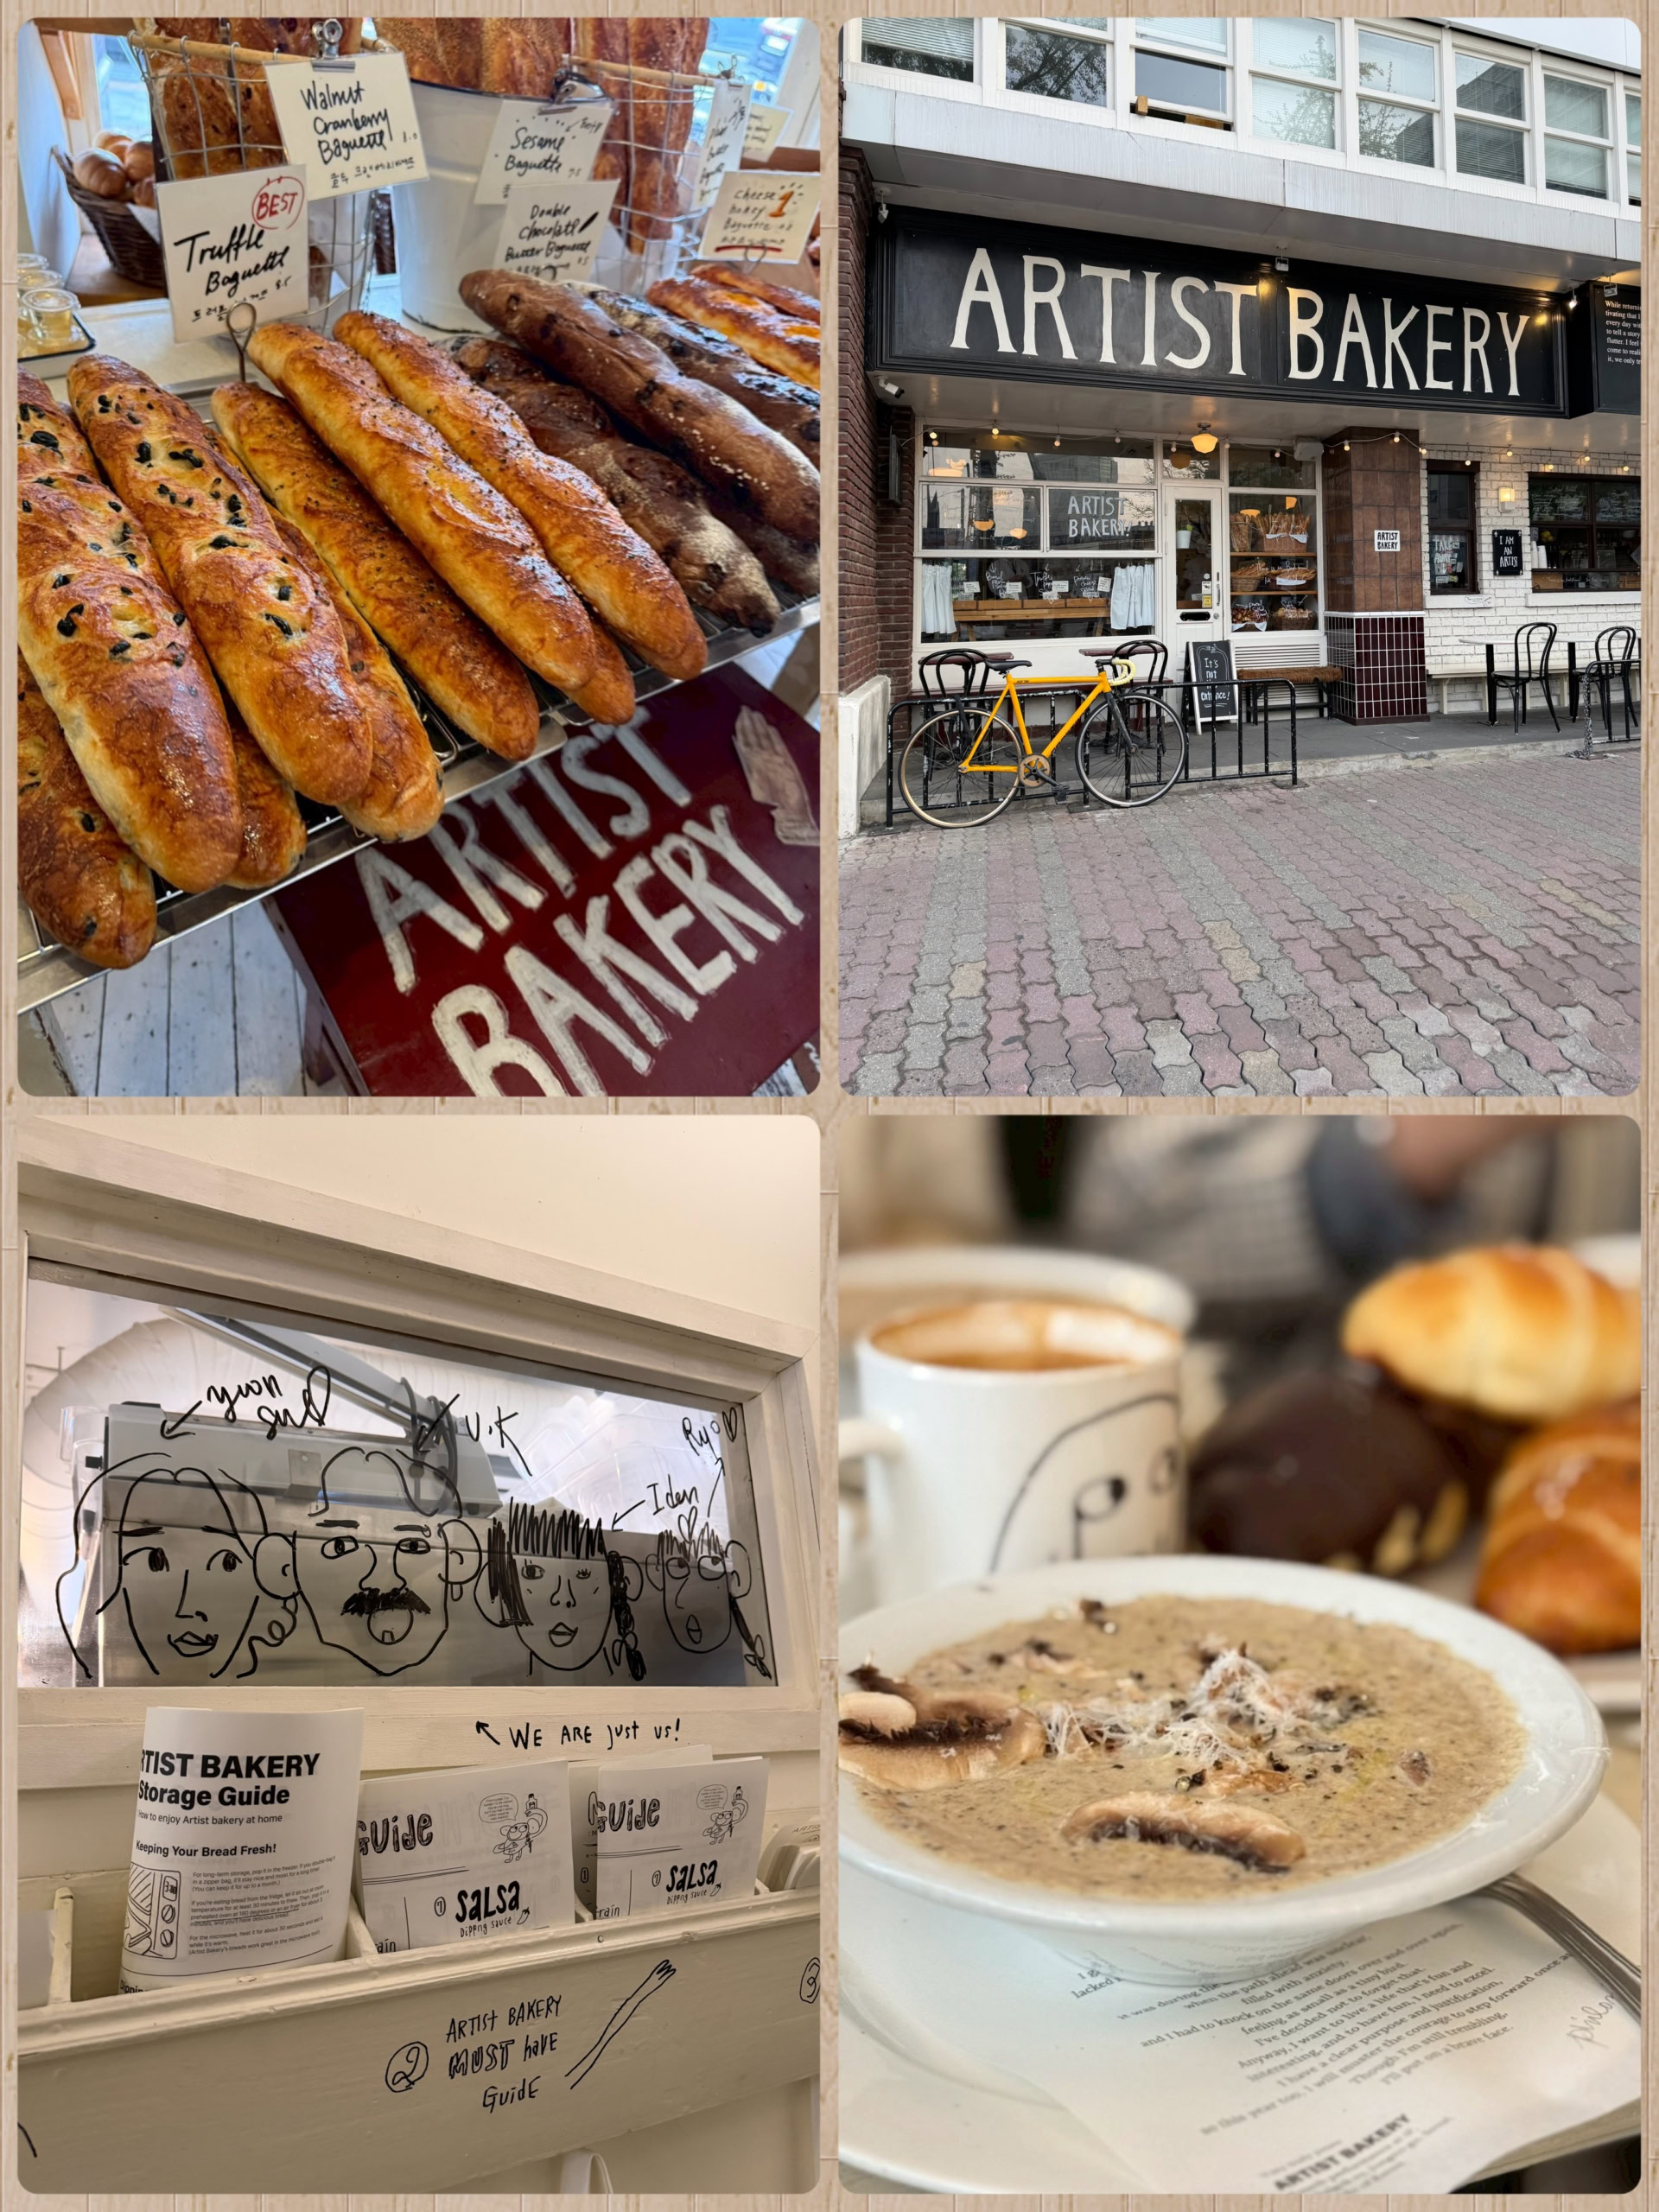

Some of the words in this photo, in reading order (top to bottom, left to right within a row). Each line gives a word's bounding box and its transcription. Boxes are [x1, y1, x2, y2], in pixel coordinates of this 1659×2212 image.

[300, 80, 365, 111] Walnut
[313, 108, 393, 142] Cranberry
[318, 130, 387, 165] Baguette
[510, 126, 566, 153] Sesame
[504, 154, 563, 177] Baguette
[256, 192, 298, 221] BEST
[530, 203, 571, 220] Double
[174, 223, 265, 273] Truffle
[545, 240, 591, 260] Baguette
[206, 245, 289, 298] Baguette
[950, 247, 1258, 376] ARTIST
[1287, 286, 1530, 397] BAKERY
[1605, 310, 1625, 319] tivating
[1067, 496, 1126, 516] ARTIST
[1068, 518, 1133, 537] BAKERY!
[1377, 531, 1398, 541] ARTIST
[1499, 536, 1503, 545] I
[1505, 537, 1514, 545] AM
[1433, 537, 1452, 551] TAKE
[1503, 546, 1512, 555] AN
[1499, 556, 1518, 568] ARTIST
[1205, 658, 1219, 669] It's
[1206, 671, 1217, 679] not
[1200, 691, 1230, 702] entnce!
[356, 705, 693, 995] ARTIST
[431, 804, 805, 1096] BAKERY
[646, 1473, 700, 1516] Iden
[510, 1722, 543, 1750] WE
[560, 1725, 593, 1745] ARE
[653, 1718, 682, 1742] us!
[200, 1753, 321, 1778] BAKERY
[139, 1780, 212, 1810] Storage
[218, 1785, 290, 1806] Guide
[158, 1814, 181, 1825] enjoy
[183, 1815, 209, 1825] Artist
[212, 1816, 244, 1826] bakery
[257, 1815, 283, 1823] home
[136, 1840, 169, 1857] Keeping
[172, 1846, 199, 1857] Your
[201, 1846, 237, 1857] Bread
[240, 1844, 276, 1855] Fresh!
[690, 1890, 707, 1898] sauce
[491, 1917, 512, 1929] sauce
[1071, 1977, 1114, 1999] lacked
[1241, 1990, 1274, 2005] filled
[1303, 1960, 1350, 1982] anxiety,
[508, 1995, 563, 2027] BAKERY
[1158, 1990, 1201, 2007] during
[1213, 2012, 1255, 2026] knock
[1325, 1969, 1358, 1986] doors
[1281, 2012, 1328, 2037] decided
[1361, 1979, 1400, 1997] forget
[1357, 2010, 1390, 2027] have
[1421, 1984, 1450, 1999] need
[1463, 1967, 1496, 1984] excel.
[1405, 2014, 1453, 2037] courage
[1489, 1975, 1535, 2004] forward
[1237, 2045, 1293, 2069] Anyway,
[1298, 2026, 1331, 2044] want
[1396, 1977, 1430, 1995] that's
[1241, 2018, 1287, 2035] feeling
[1300, 1993, 1334, 2012] small
[1328, 2042, 1360, 2063] clear
[1359, 2017, 1408, 2045] purpose
[1430, 1980, 1504, 2012] justification,
[1445, 2012, 1509, 2037] trembling,
[448, 2039, 515, 2079] MUST
[1274, 2156, 1340, 2190] ARTIST
[1340, 2113, 1409, 2158] BAKERY
